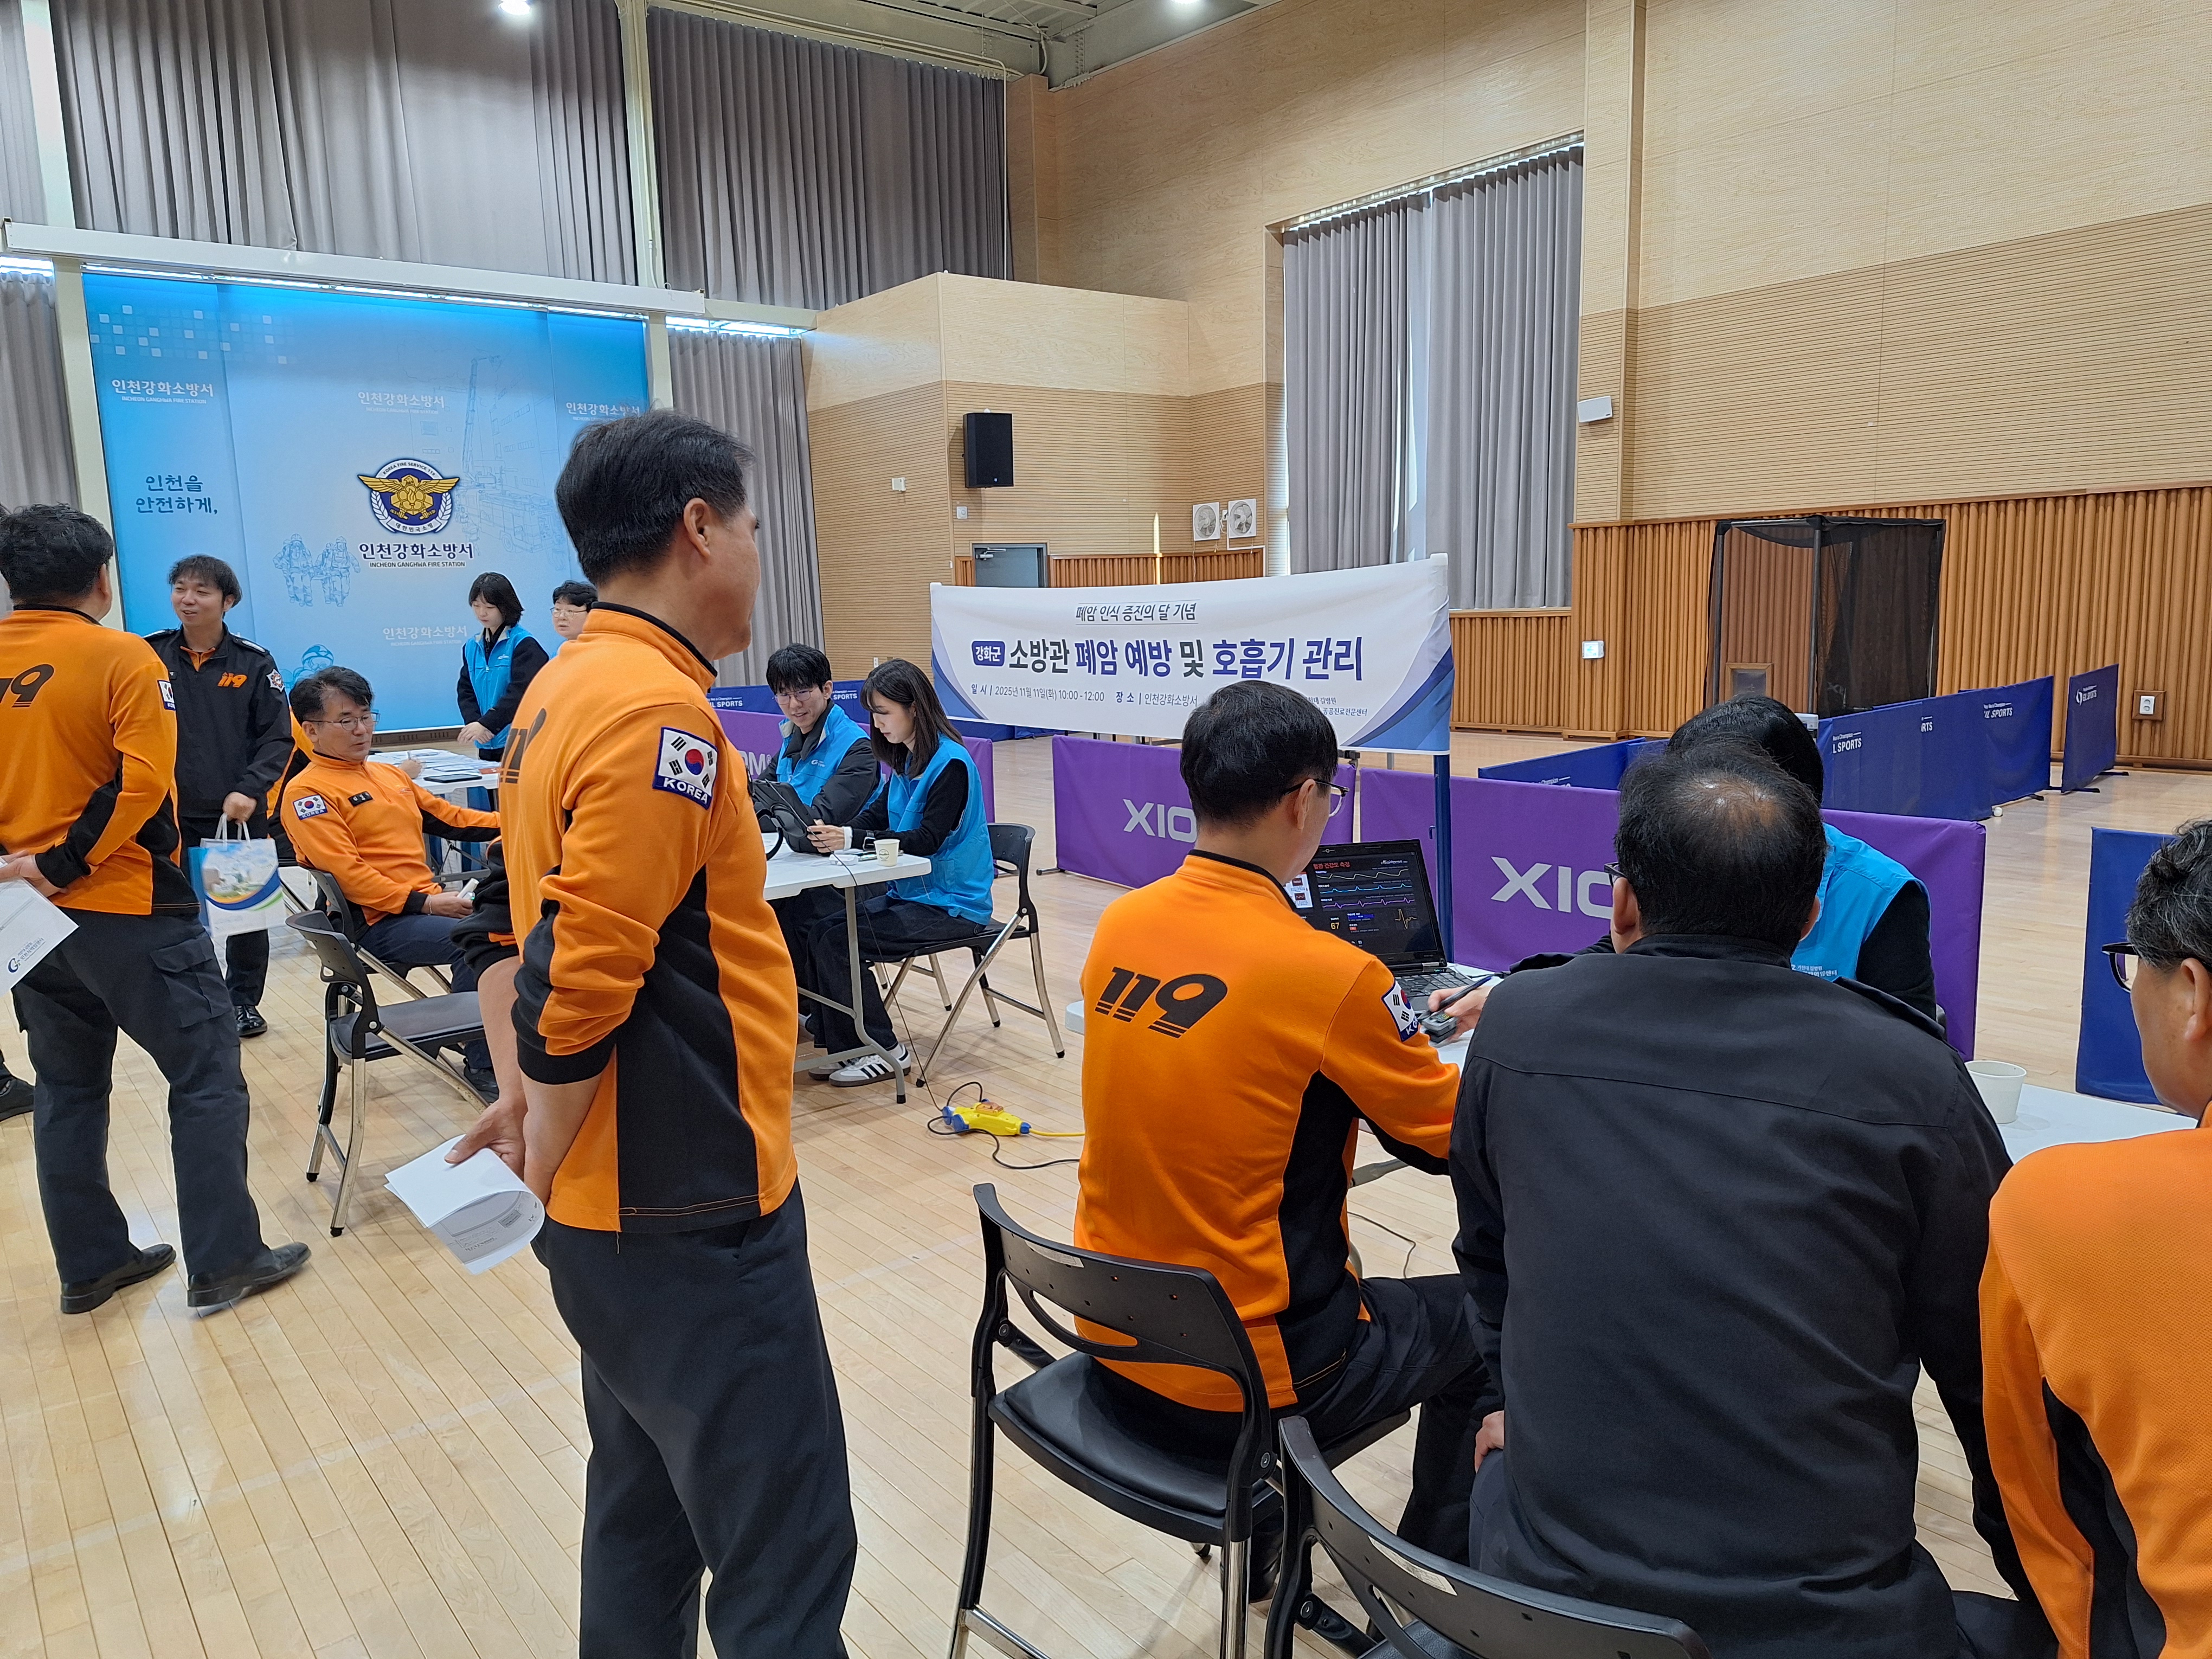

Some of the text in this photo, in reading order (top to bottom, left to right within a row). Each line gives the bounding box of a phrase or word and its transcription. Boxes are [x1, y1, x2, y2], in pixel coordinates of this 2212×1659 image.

[112, 379, 214, 397] 인천강화소방서
[358, 391, 445, 408] 인천강화소방서
[383, 465, 397, 475] KOREA
[408, 462, 427, 471] SERVICE
[146, 474, 203, 492] 인천을
[136, 497, 217, 515] 안전하게,
[359, 543, 473, 560] 인천강화소방서
[1076, 602, 1197, 622] 폐암 인식 증진의 달 기념
[383, 625, 468, 640] 인천강화소방서
[975, 636, 1362, 681] 강화군 소방관 폐암 예방 및 호흡기 관리
[971, 684, 978, 695] 일
[980, 684, 987, 695] 시
[995, 686, 1018, 697] 2025년
[1019, 687, 1032, 698] 11월
[1033, 687, 1057, 701] 11일(화)
[1058, 690, 1078, 700] 10:00
[1084, 691, 1104, 702] 12:00
[1116, 691, 1124, 703] 장
[1126, 692, 1134, 703] 소
[1144, 693, 1198, 707] 인천강화소방서
[1320, 697, 1336, 705] 길병원
[1323, 708, 1367, 716] 공공진료전문센터
[1991, 707, 2012, 718] SPORTS
[1837, 737, 1862, 753] SPORTS
[664, 777, 708, 805] KOREA
[301, 809, 325, 819] KOREA
[1123, 799, 1198, 843] XIO
[1491, 856, 1614, 919] XIO
[1094, 966, 1228, 1039] 119
